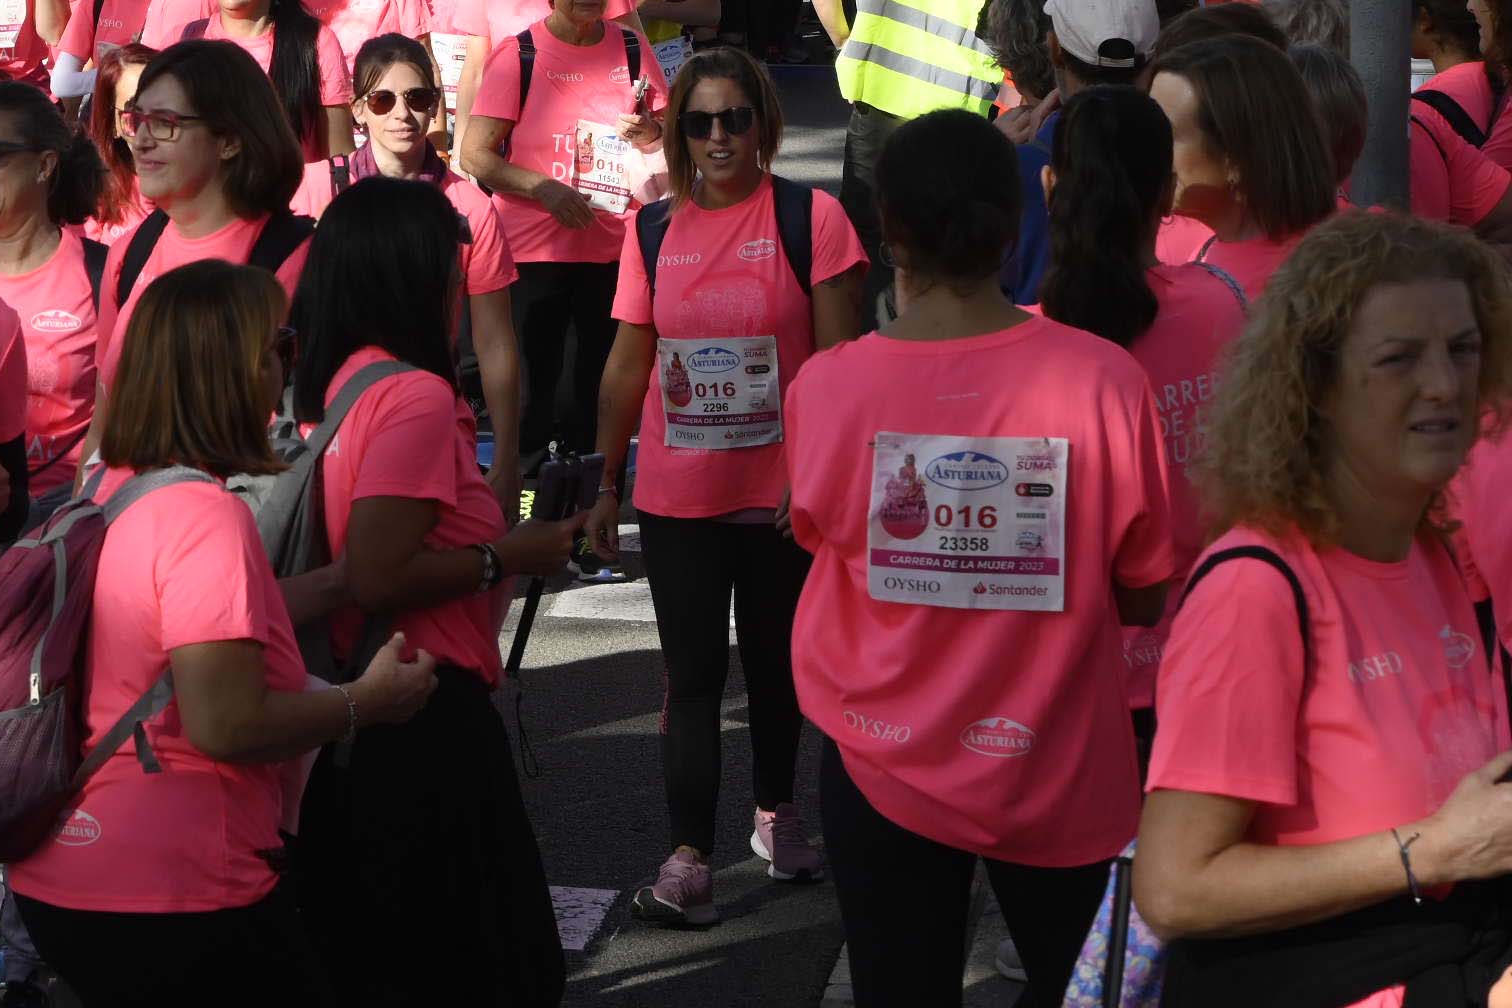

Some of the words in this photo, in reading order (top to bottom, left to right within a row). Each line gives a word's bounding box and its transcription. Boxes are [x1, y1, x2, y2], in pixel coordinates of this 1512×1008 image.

[596, 159, 625, 173] 016
[656, 253, 701, 268] OYSHO
[691, 357, 736, 368] ASTURIANA
[743, 351, 768, 359] SUMA
[695, 381, 736, 398] 016
[703, 402, 729, 413] 2296
[726, 416, 750, 424] MUJER
[675, 430, 705, 441] OYSHO
[734, 428, 775, 439] Santander
[932, 464, 1002, 481] ASTURIANA
[1016, 461, 1053, 471] SUMA
[934, 504, 998, 529] 016
[939, 536, 989, 552] 23358
[889, 555, 941, 567] CARRERA
[943, 559, 958, 569] DE
[960, 559, 975, 569] LA
[977, 560, 1016, 570] MUJER
[1019, 561, 1045, 571] 2023
[883, 576, 941, 593] OYSHO
[989, 582, 1049, 597] Santander
[843, 710, 912, 744] OYSHO
[966, 729, 1032, 748] ASTURIANA
